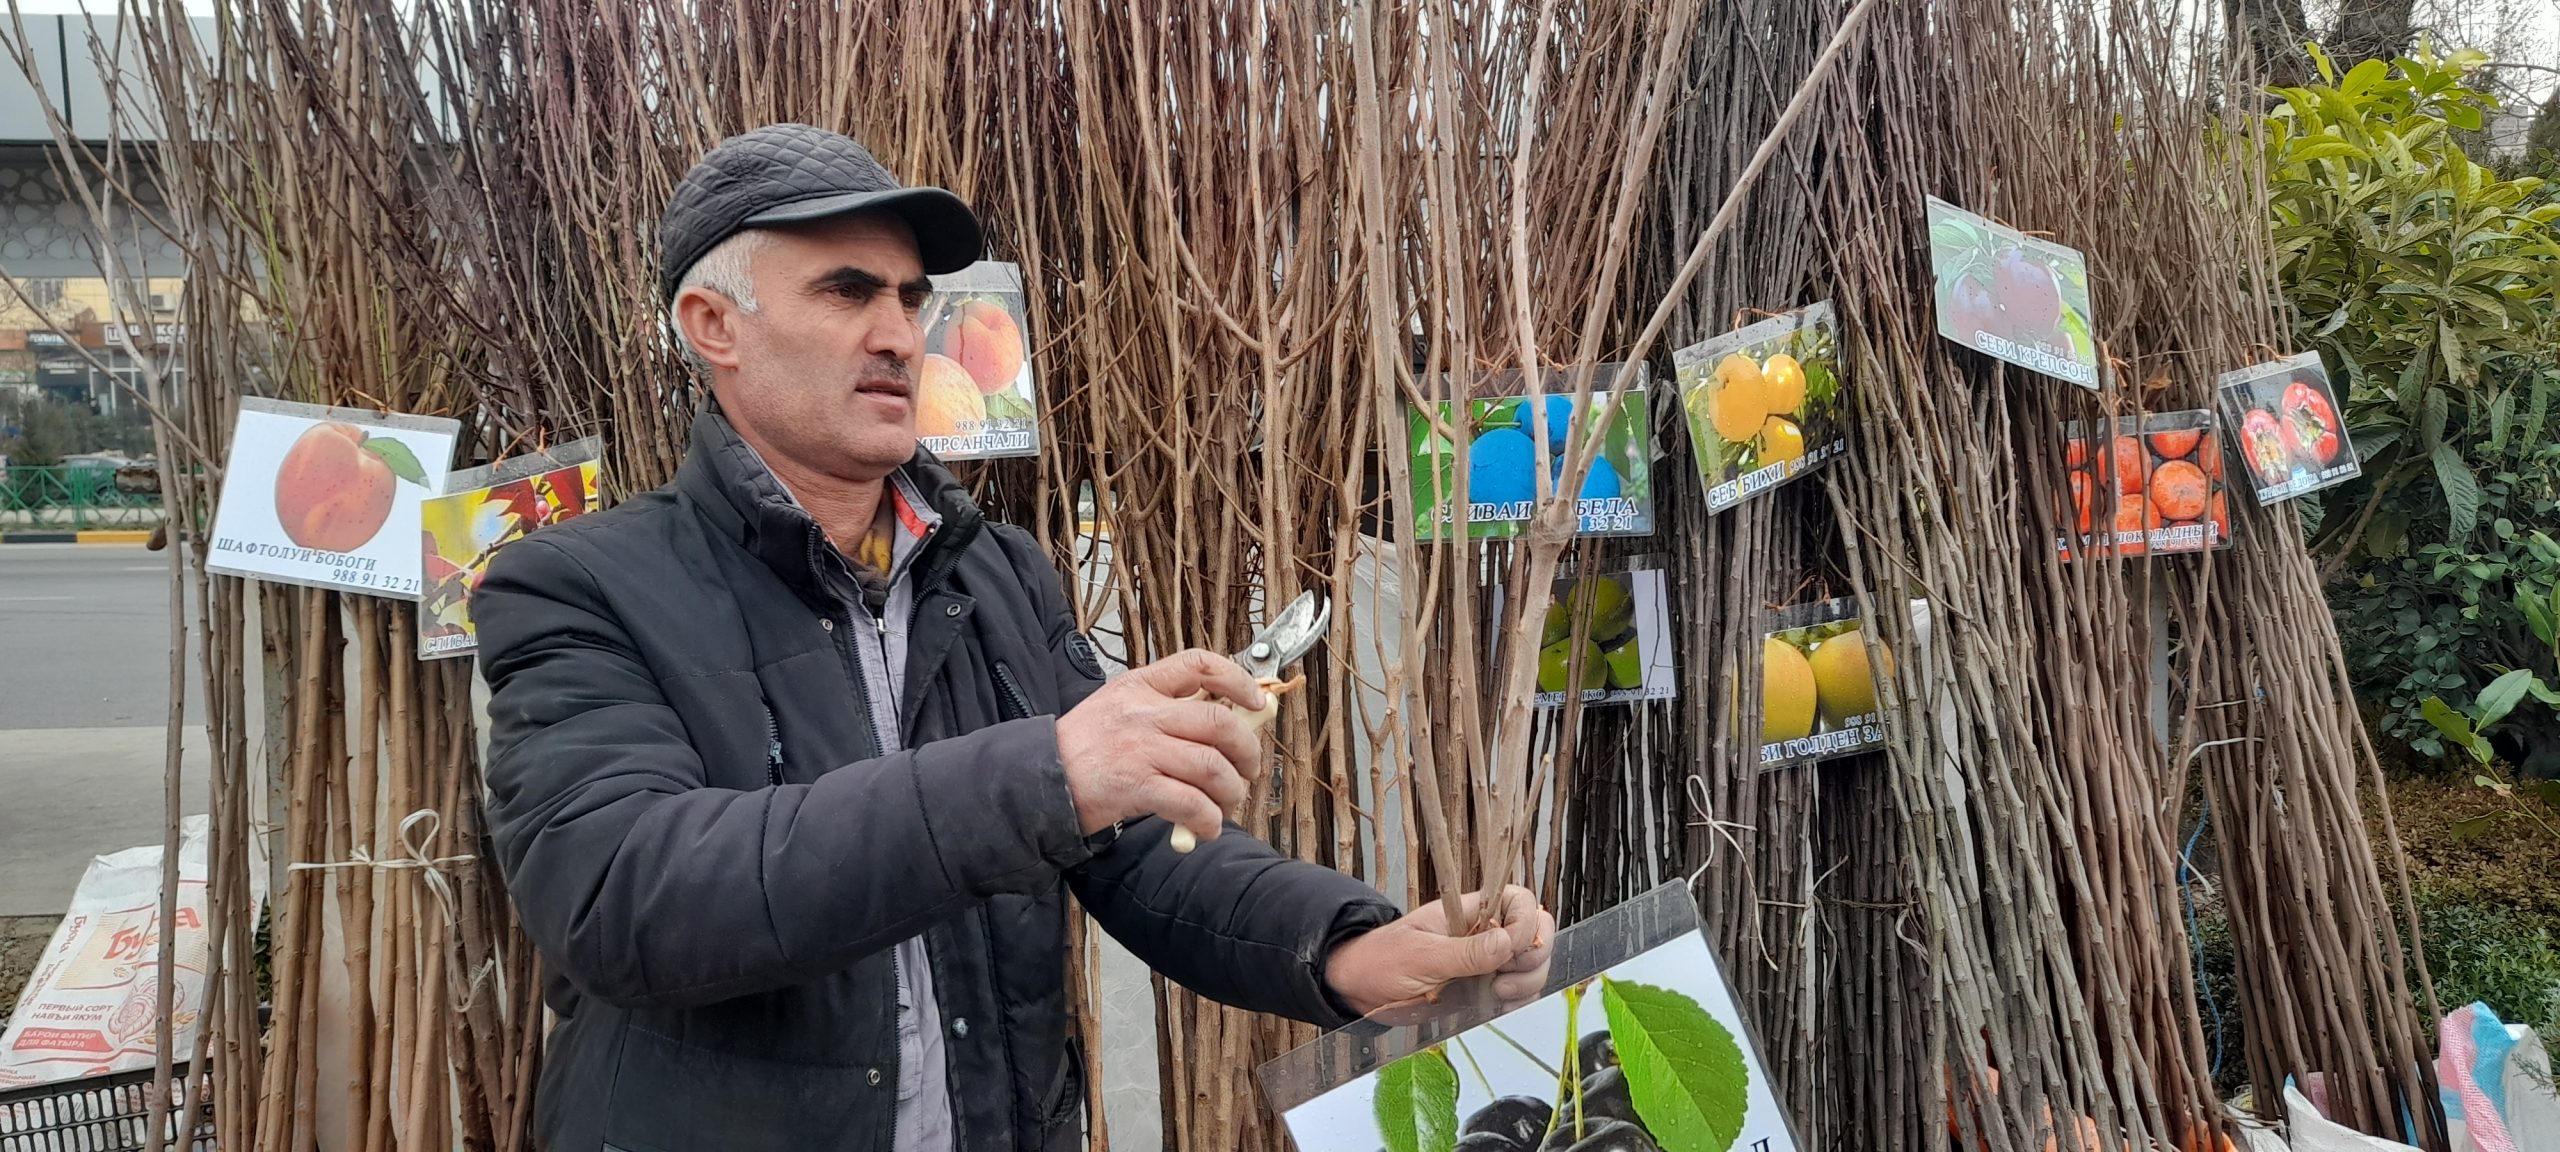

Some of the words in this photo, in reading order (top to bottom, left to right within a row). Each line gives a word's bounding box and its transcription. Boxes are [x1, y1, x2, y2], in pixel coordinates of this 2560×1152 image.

[1975, 331, 2017, 360] СЕБИ
[2019, 345, 2093, 383] КРЕПСОН
[954, 420, 975, 431] 988
[979, 419, 994, 430] 91
[1708, 480, 1737, 508] СЕБ
[1741, 460, 1786, 496] БИХИ
[1576, 498, 1638, 517] БЕДА
[1589, 516, 1609, 532] 32
[1614, 515, 1633, 531] 21
[314, 550, 378, 571] БОБОГИ
[331, 568, 356, 584] 988
[361, 572, 377, 587] 91
[381, 575, 399, 590] 32
[403, 578, 420, 593] 21
[1659, 686, 1670, 696] 21
[1759, 741, 1783, 764] БИ
[1785, 726, 1862, 758] ГОЛДЕН
[1862, 724, 1884, 743] ЗА
[71, 1013, 103, 1021] ЯКУМ
[85, 1004, 114, 1012] СОРТ
